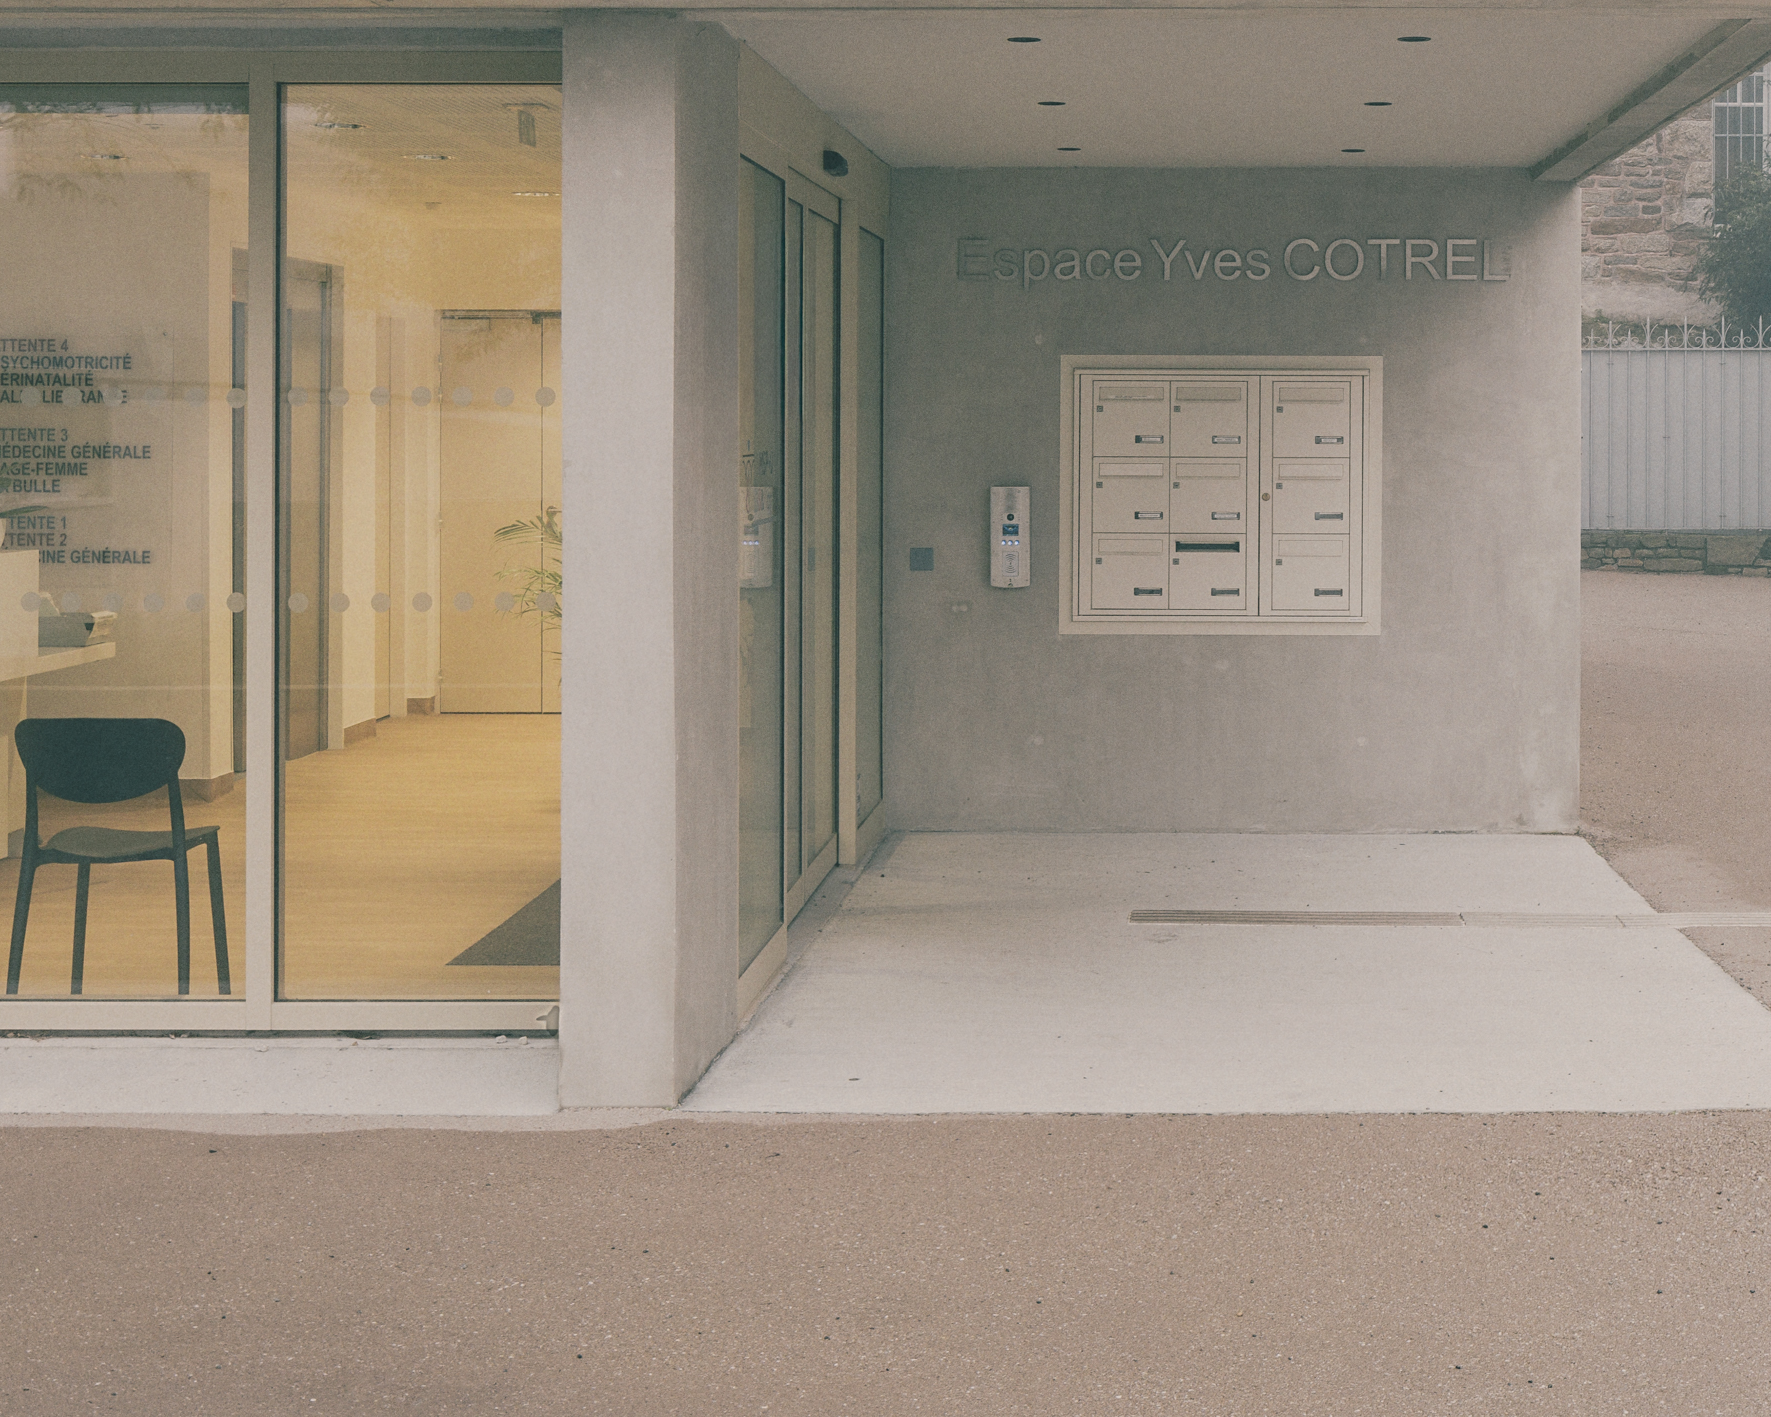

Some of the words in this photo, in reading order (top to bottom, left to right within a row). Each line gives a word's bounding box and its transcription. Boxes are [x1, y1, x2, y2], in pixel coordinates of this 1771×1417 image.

[955, 237, 1143, 289] Espace
[1150, 238, 1271, 282] Yves
[1282, 237, 1510, 282] COTREL
[60, 338, 69, 353] 4
[60, 428, 69, 442] 3
[71, 442, 152, 459] GÉNÉRALE
[12, 478, 61, 493] BULLE
[7, 515, 55, 530] TENTE
[60, 515, 67, 530] 1
[59, 532, 68, 547] 2
[70, 547, 151, 564] GÉNÉRALE
